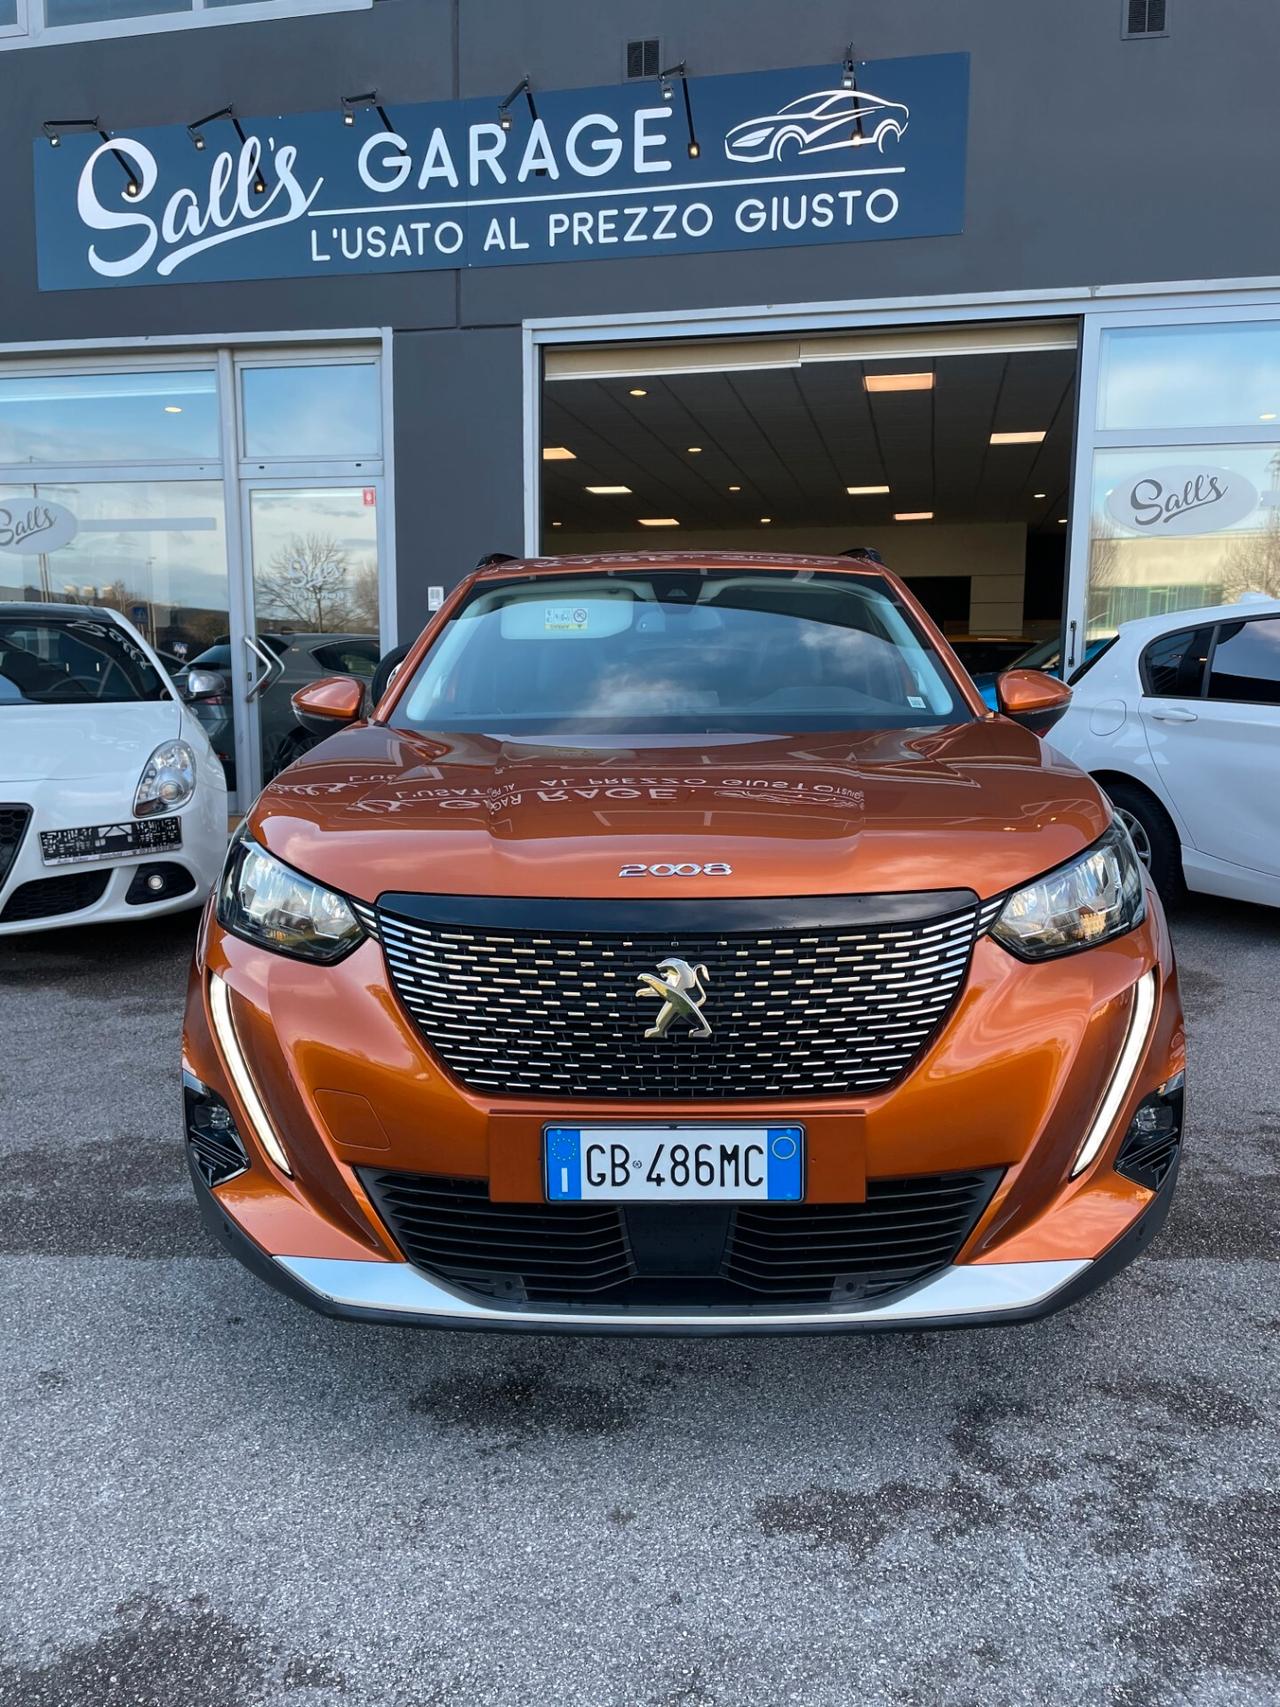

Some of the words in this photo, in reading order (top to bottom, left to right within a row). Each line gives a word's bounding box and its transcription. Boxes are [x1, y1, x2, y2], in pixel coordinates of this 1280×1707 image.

[358, 106, 673, 193] GARAGE
[77, 135, 324, 277] Sall's
[311, 220, 464, 262] L'USATO
[483, 216, 530, 252] AL
[548, 202, 713, 248] PREZZO
[734, 188, 899, 233] GIUSTO
[1131, 474, 1228, 525] Sall's
[618, 862, 733, 877] 2008
[586, 1144, 631, 1188] GB
[646, 1143, 765, 1188] 486MC
